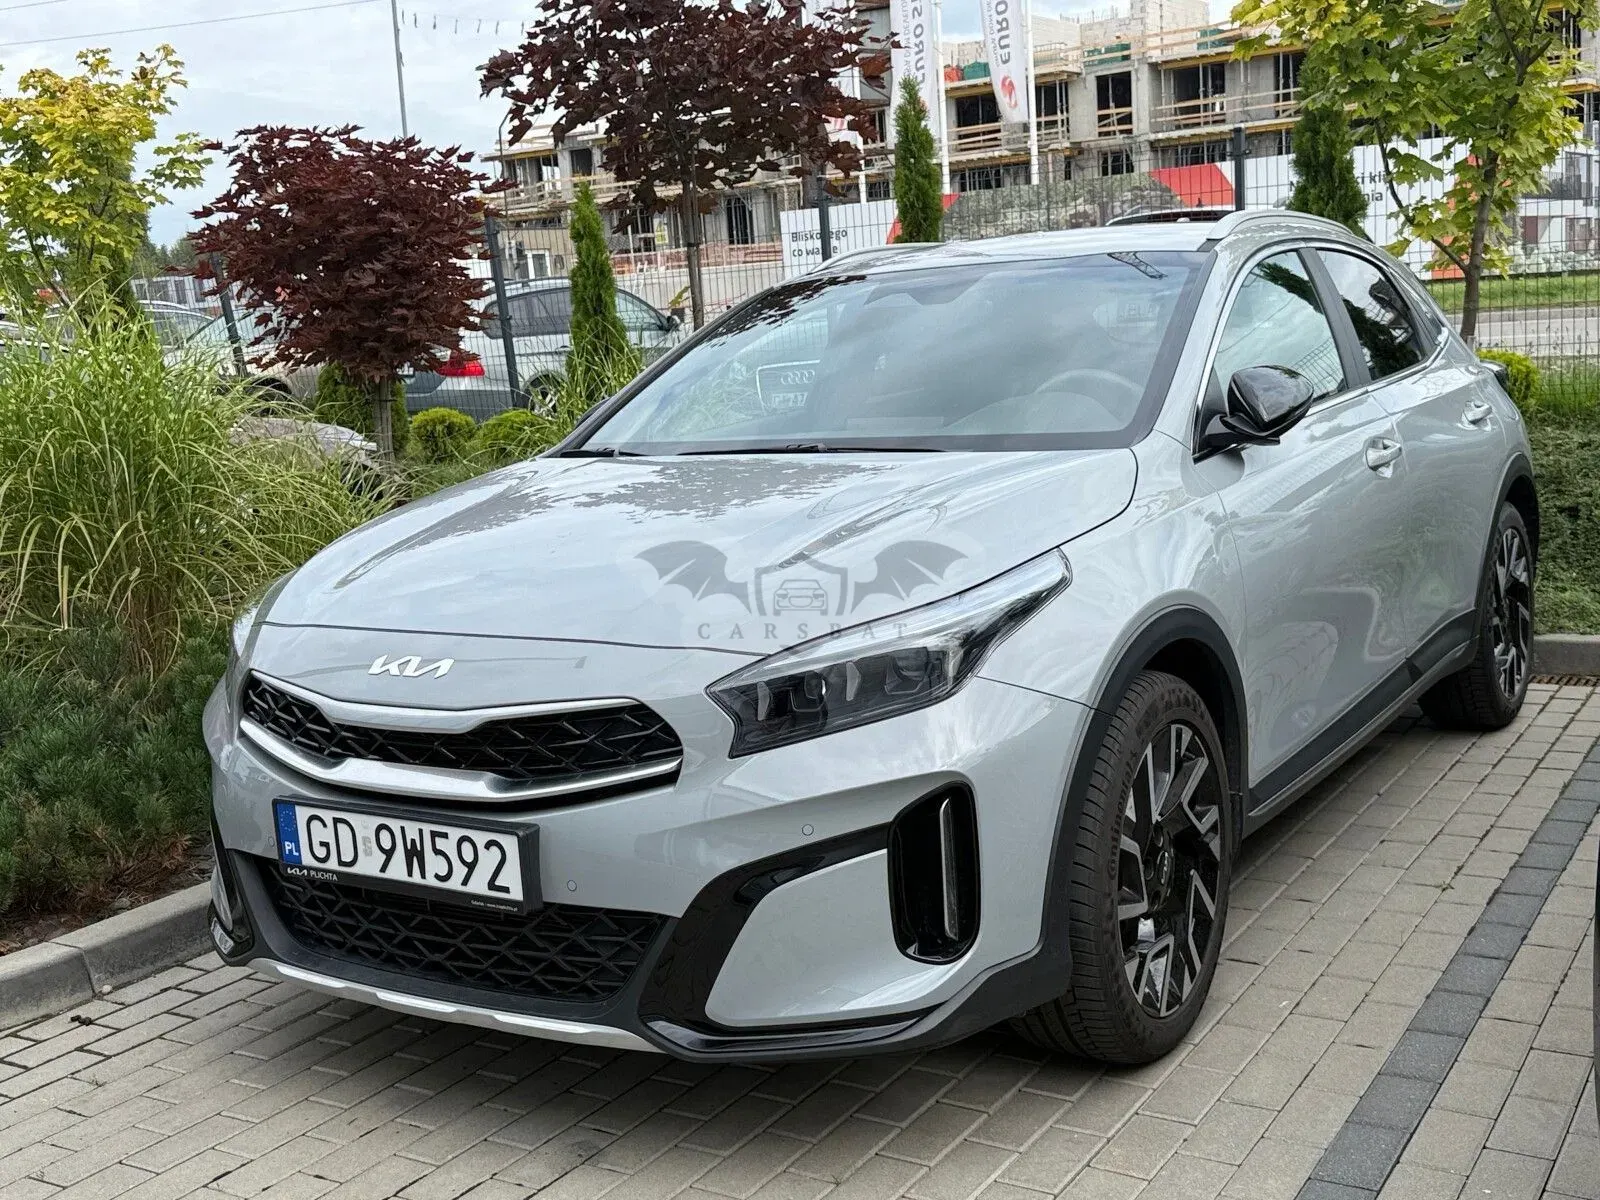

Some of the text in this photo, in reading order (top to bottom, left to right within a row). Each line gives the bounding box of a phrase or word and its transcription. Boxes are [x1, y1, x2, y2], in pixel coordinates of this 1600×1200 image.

[791, 231, 821, 242] Blisko
[792, 245, 838, 257] co wae
[367, 654, 455, 679] KIA
[284, 841, 300, 857] PL
[305, 813, 511, 894] GD 9W592
